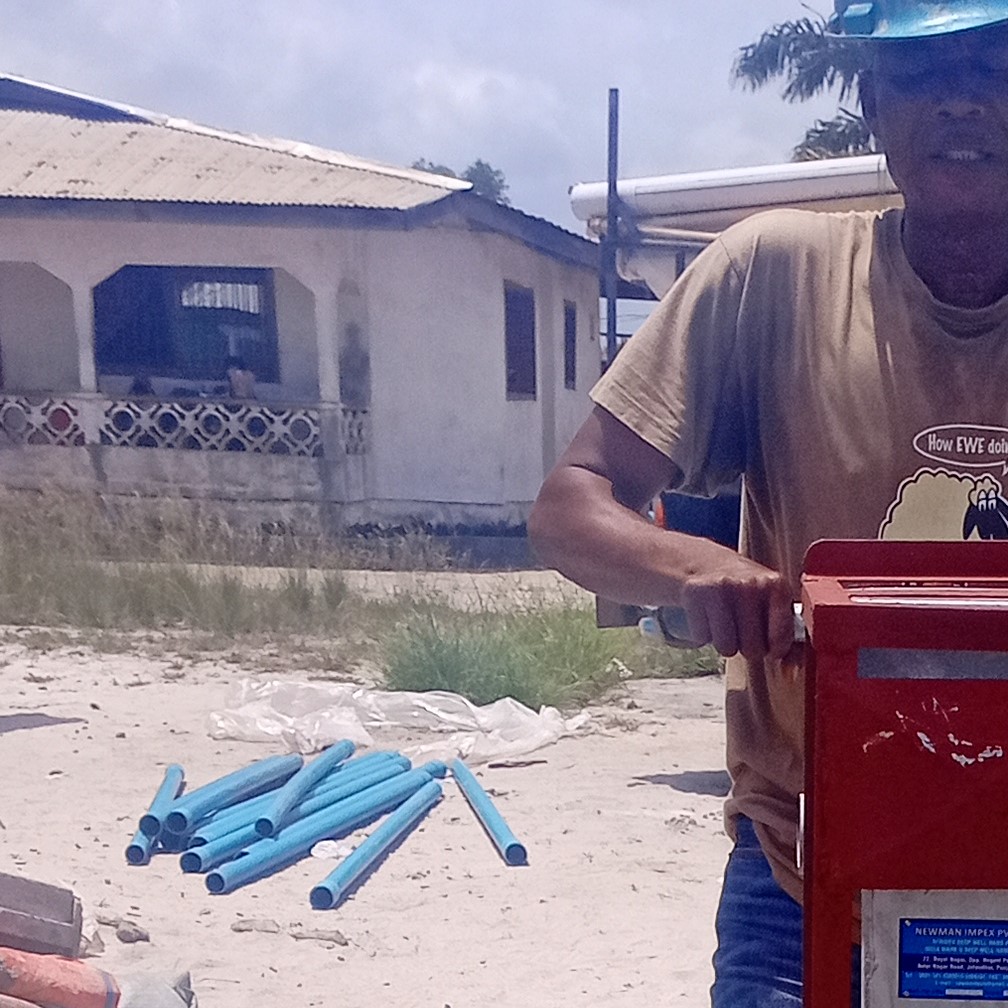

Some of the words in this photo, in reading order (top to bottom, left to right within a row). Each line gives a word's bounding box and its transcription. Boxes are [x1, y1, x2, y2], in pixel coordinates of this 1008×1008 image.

[928, 433, 953, 452] How
[956, 436, 985, 454] EWE
[915, 927, 962, 936] NEWMAN
[964, 928, 995, 937] IMPEX
